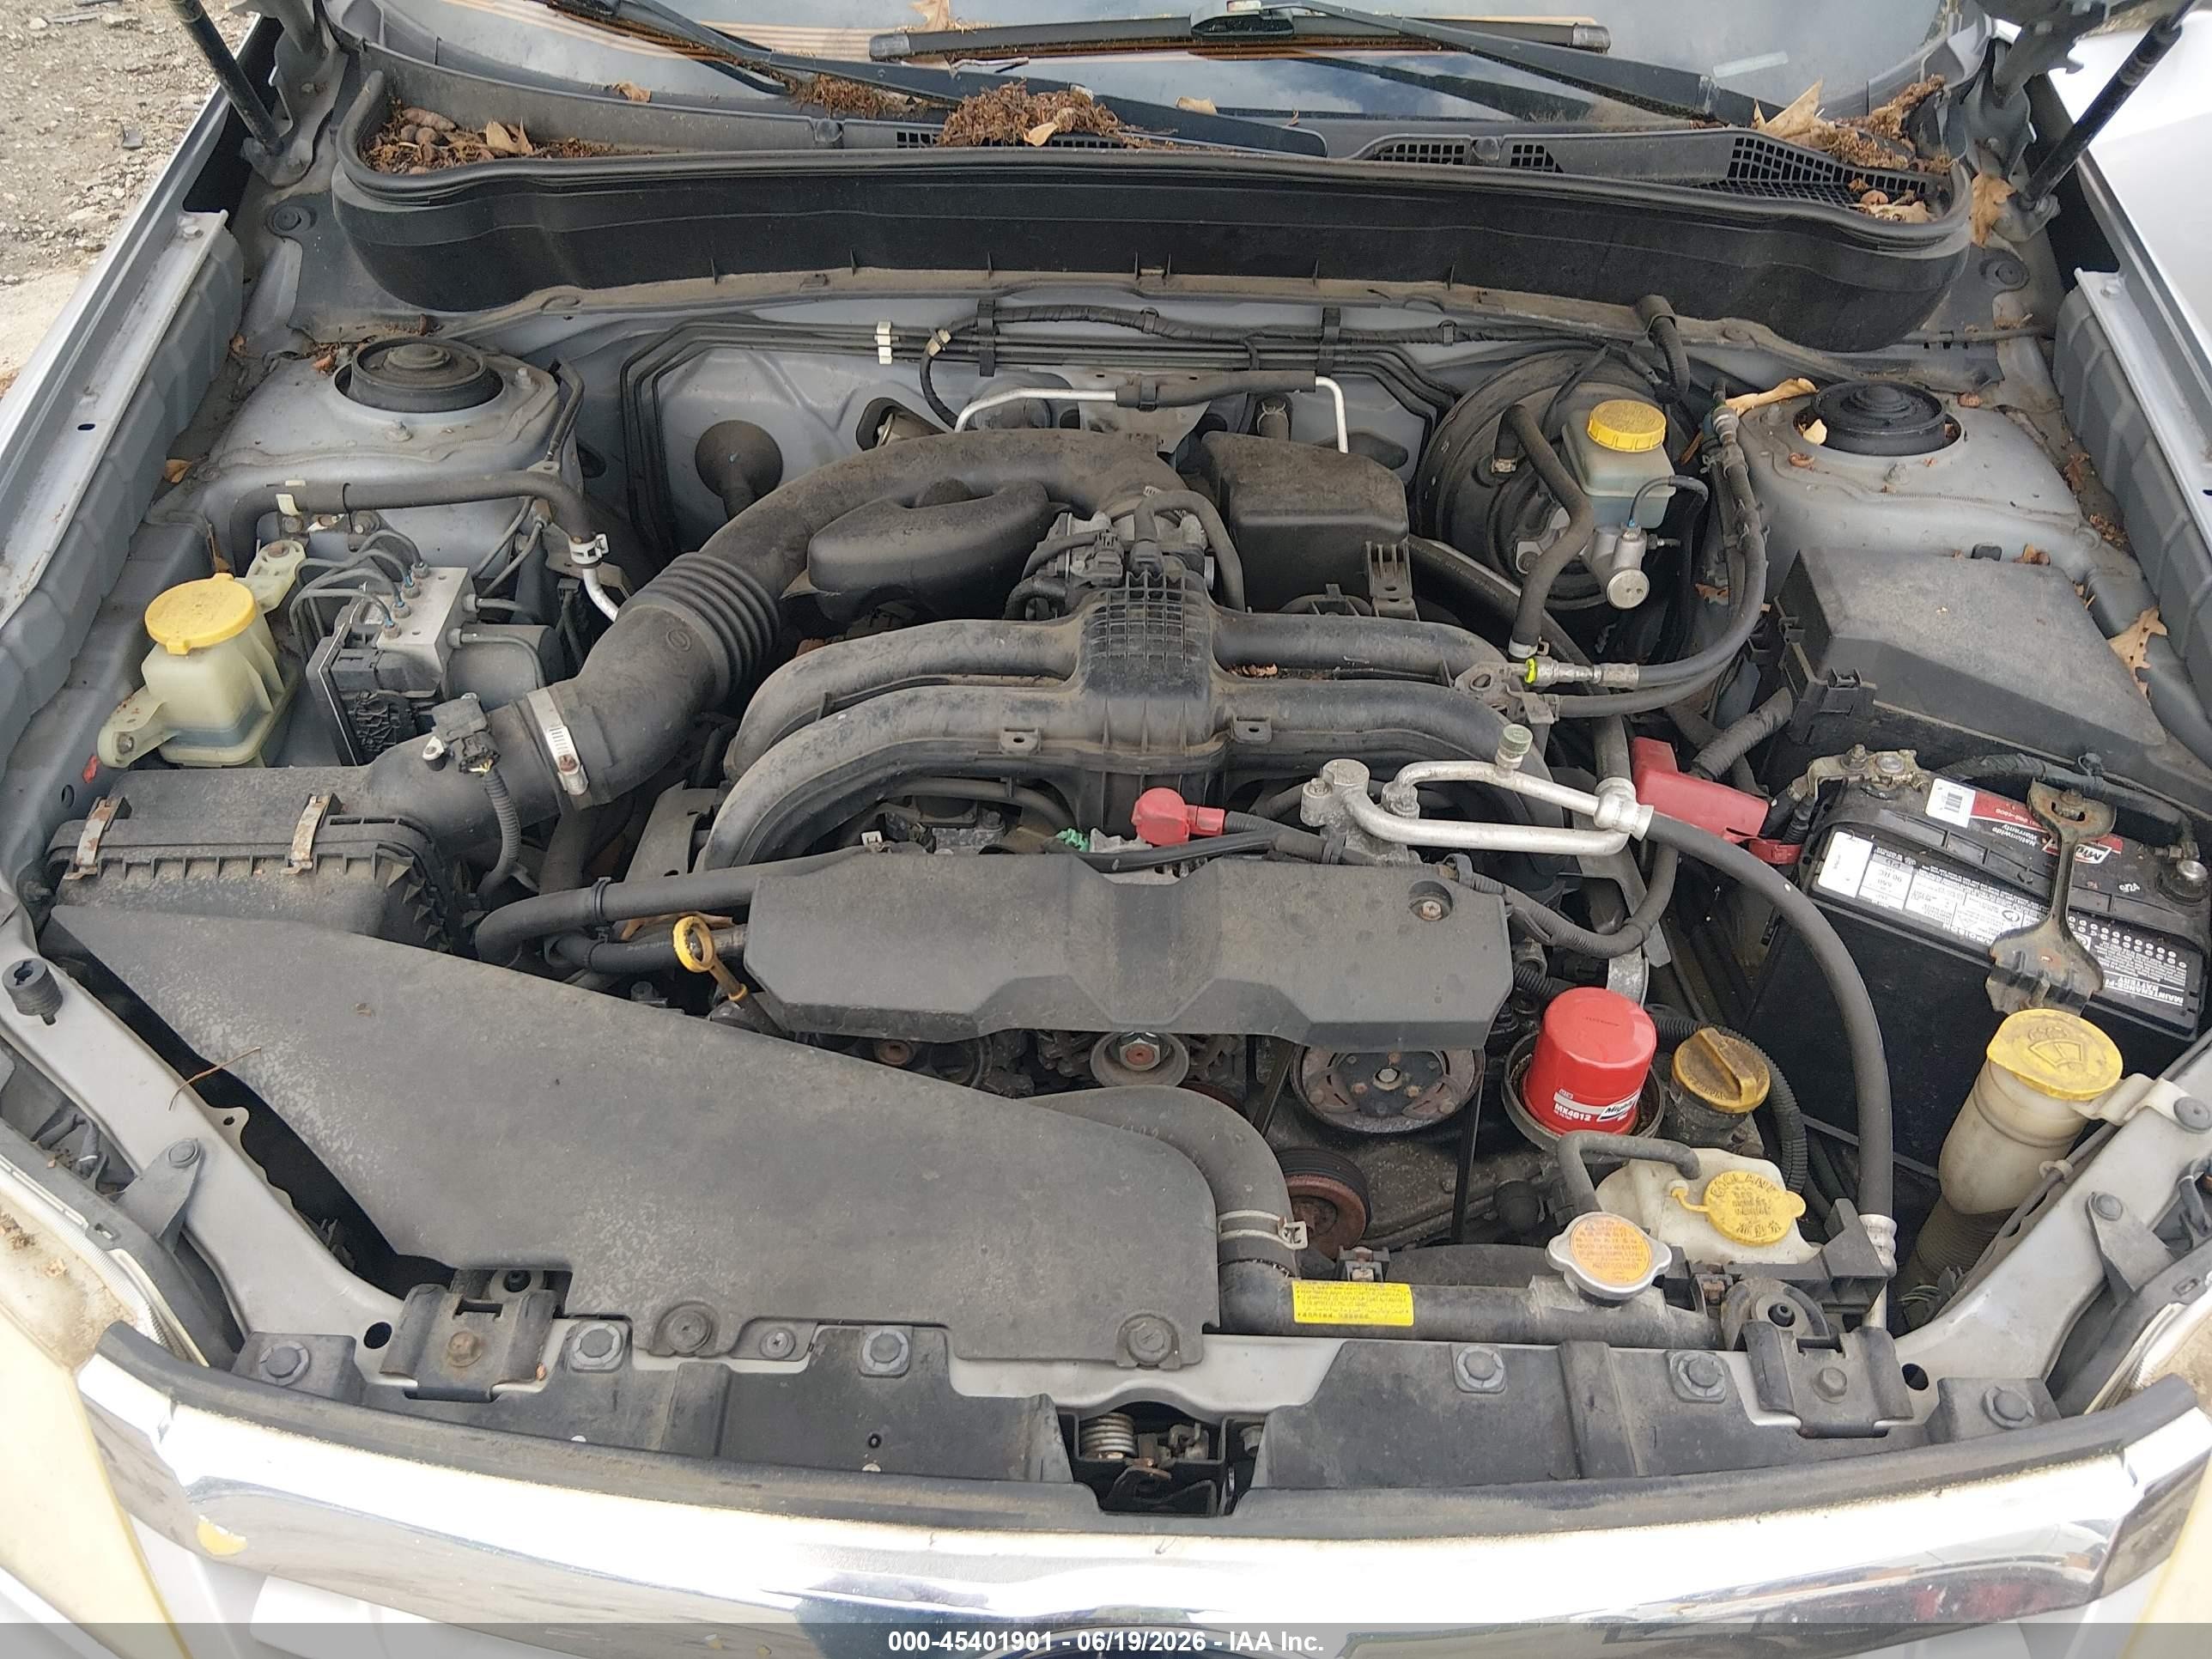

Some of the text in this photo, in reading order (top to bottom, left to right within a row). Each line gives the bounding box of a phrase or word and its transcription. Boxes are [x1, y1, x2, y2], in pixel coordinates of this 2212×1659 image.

[1992, 827, 2036, 848] Nationwide
[2002, 824, 2038, 842] Warranty
[1554, 1103, 1591, 1122] MX4012
